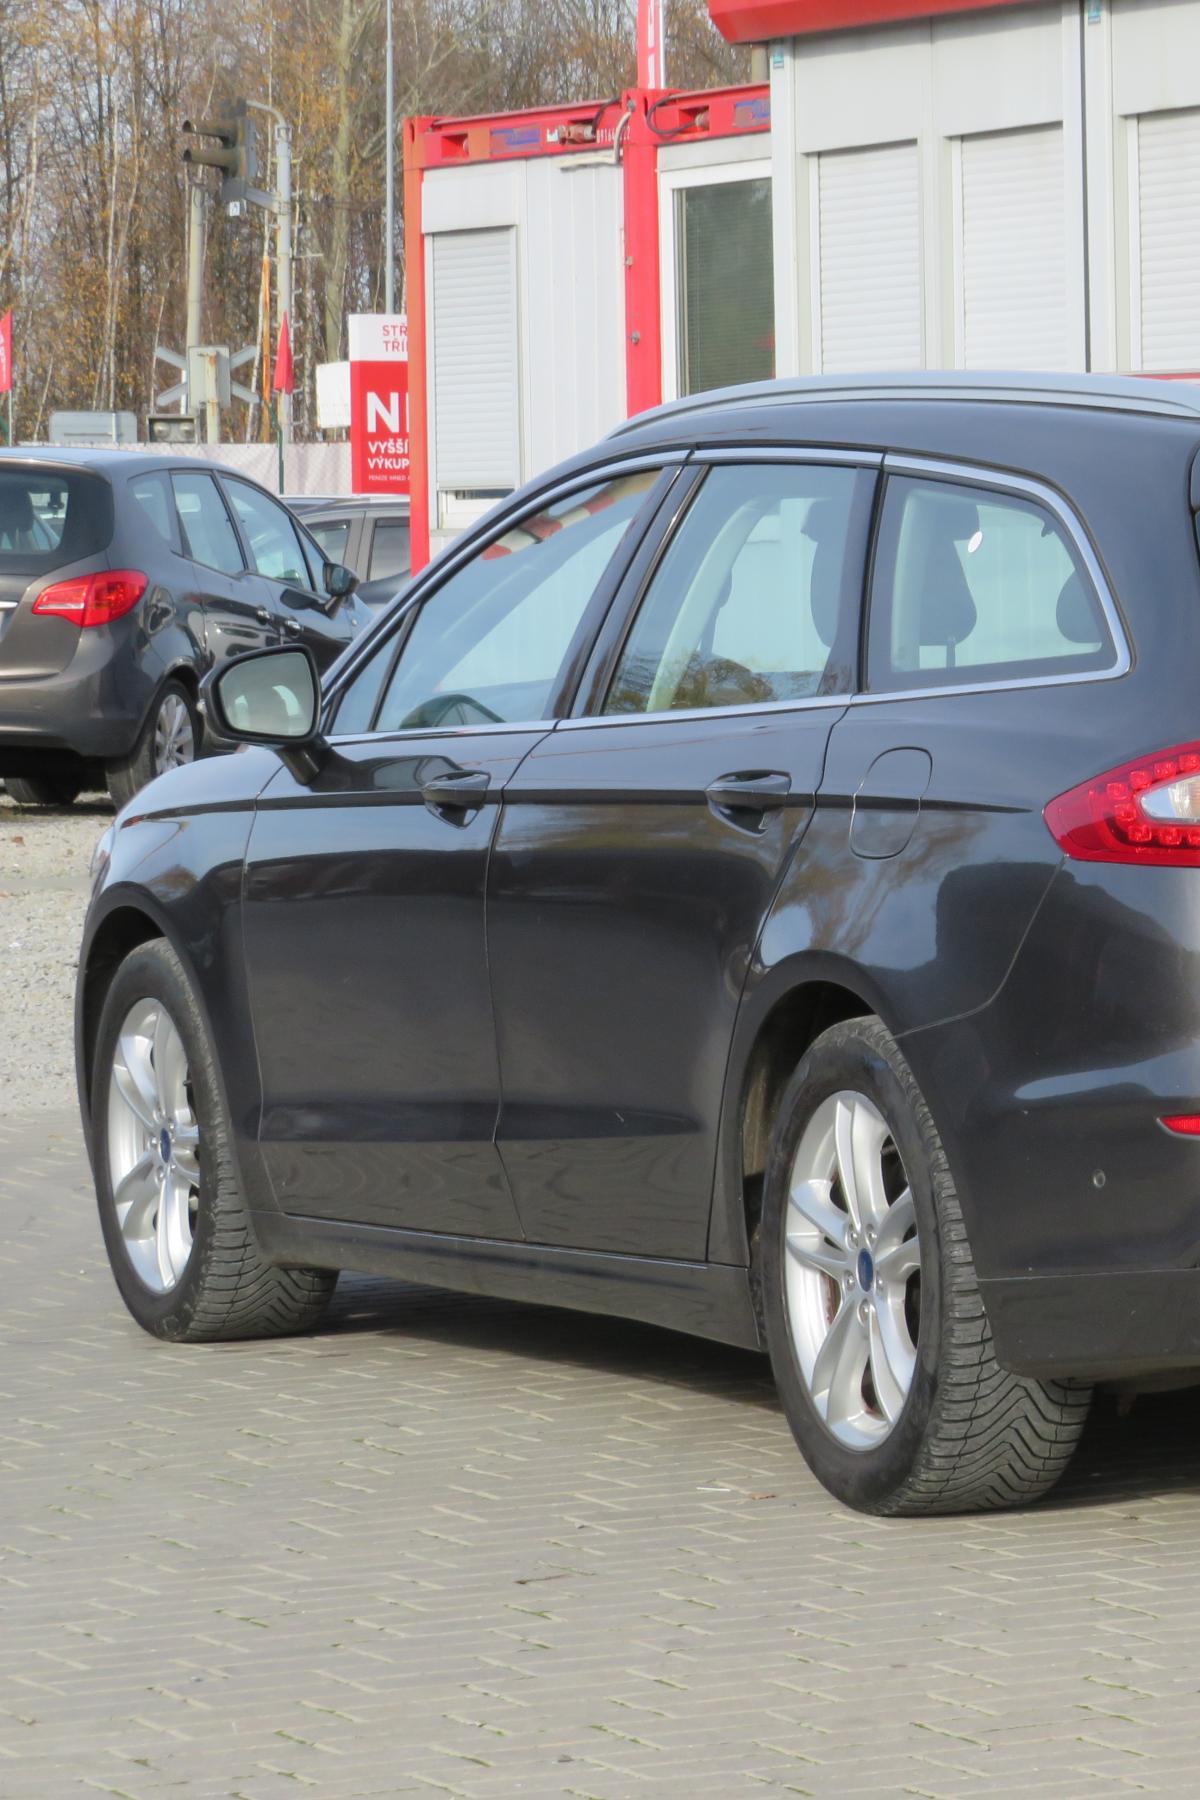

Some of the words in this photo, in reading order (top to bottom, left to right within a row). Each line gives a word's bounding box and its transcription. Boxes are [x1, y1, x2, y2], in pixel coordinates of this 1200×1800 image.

[383, 337, 408, 352] TŘÍ
[367, 391, 409, 433] N
[368, 438, 408, 454] VYŠŠÍ
